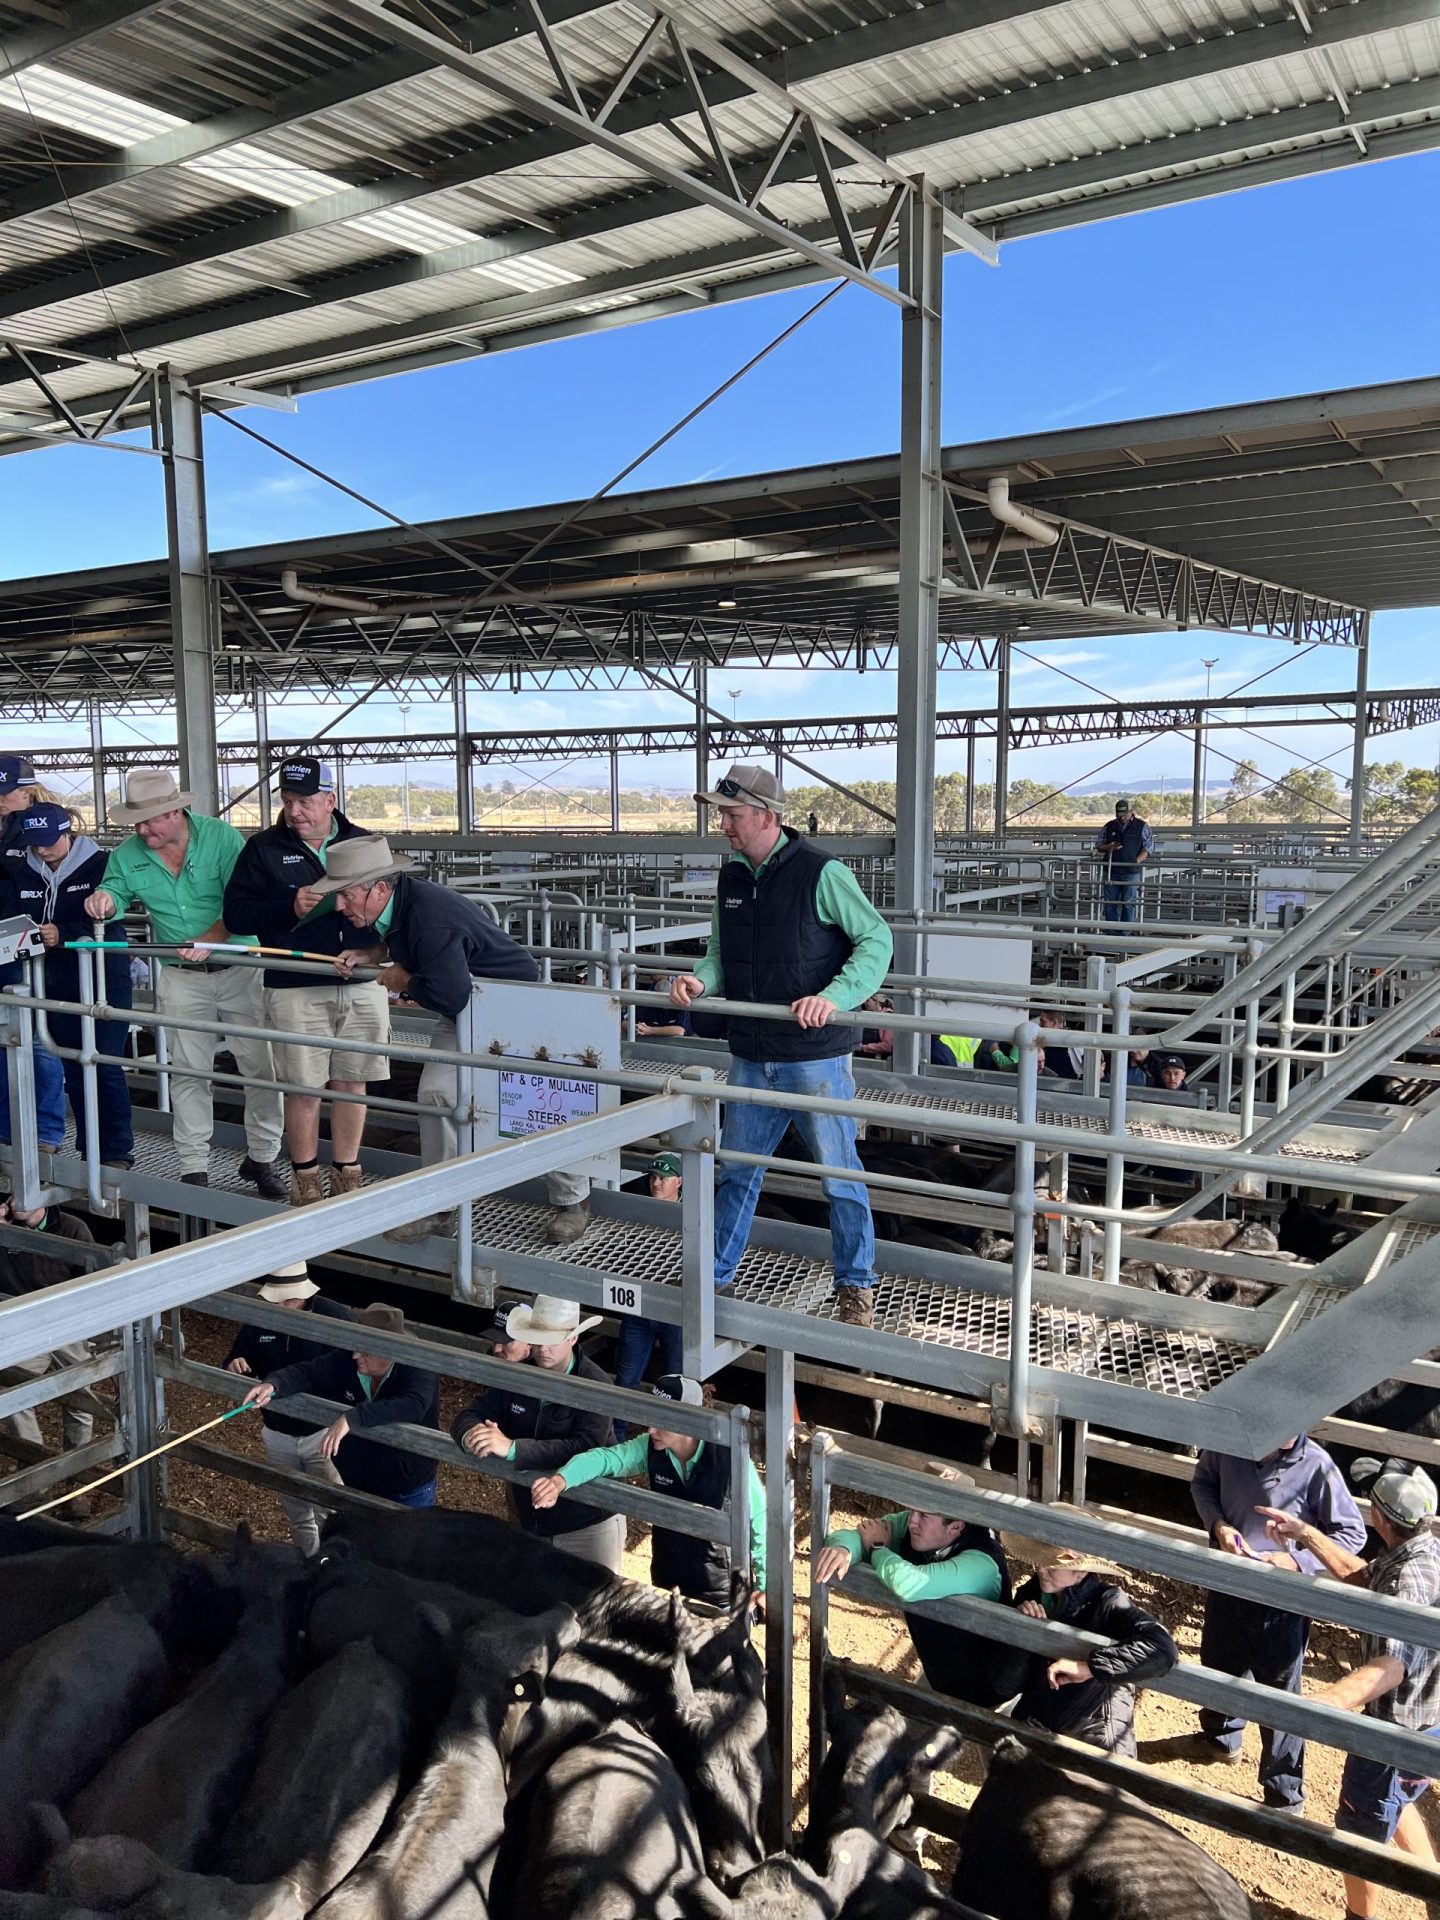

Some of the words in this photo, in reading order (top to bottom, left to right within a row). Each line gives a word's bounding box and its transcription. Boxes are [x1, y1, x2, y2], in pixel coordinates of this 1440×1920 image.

[29, 817, 48, 827] RLX
[501, 1072, 514, 1083] MT
[520, 1075, 526, 1085] &
[531, 1076, 543, 1087] CP
[549, 1079, 595, 1095] MULLANE
[501, 1092, 522, 1100] VENDOR
[534, 1088, 563, 1112] 30
[528, 1110, 567, 1126] STEERS
[610, 1286, 635, 1308] 108
